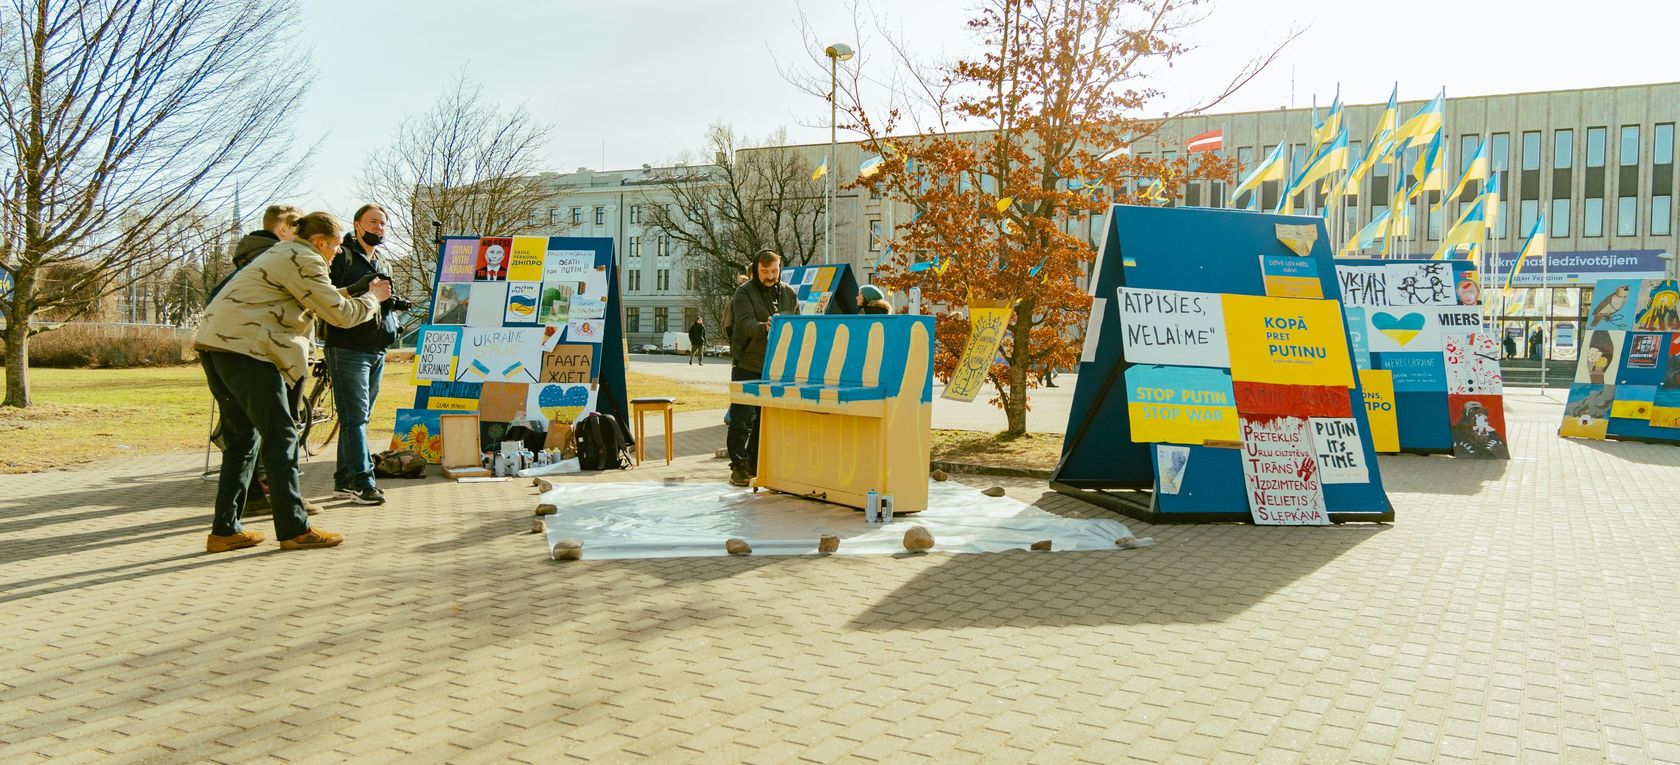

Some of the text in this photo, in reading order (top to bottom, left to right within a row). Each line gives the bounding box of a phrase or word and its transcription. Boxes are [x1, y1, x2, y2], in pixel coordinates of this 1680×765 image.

[452, 245, 473, 255] STAND
[452, 255, 469, 264] WITH
[1548, 253, 1638, 270] iedzīvotājiem
[444, 264, 475, 274] UKRAINE
[561, 266, 583, 274] PUTIN
[1264, 315, 1308, 331] KOPĀ
[425, 331, 457, 343] ROKAS
[473, 330, 528, 347] UKRAINE
[1266, 331, 1290, 341] PRET
[423, 343, 450, 354] NOST
[1269, 344, 1327, 359] PUTINU
[421, 354, 434, 363] NO
[546, 355, 592, 367] ГААГА
[1137, 386, 1175, 401] STOP
[1182, 389, 1228, 404] PUTIN
[1143, 406, 1225, 422] STOP WAR
[1315, 420, 1357, 440] PUTIN
[1319, 452, 1357, 469] TIME
[1254, 491, 1309, 506] NELIETIS
[1258, 507, 1323, 521] SLEPKAVA
